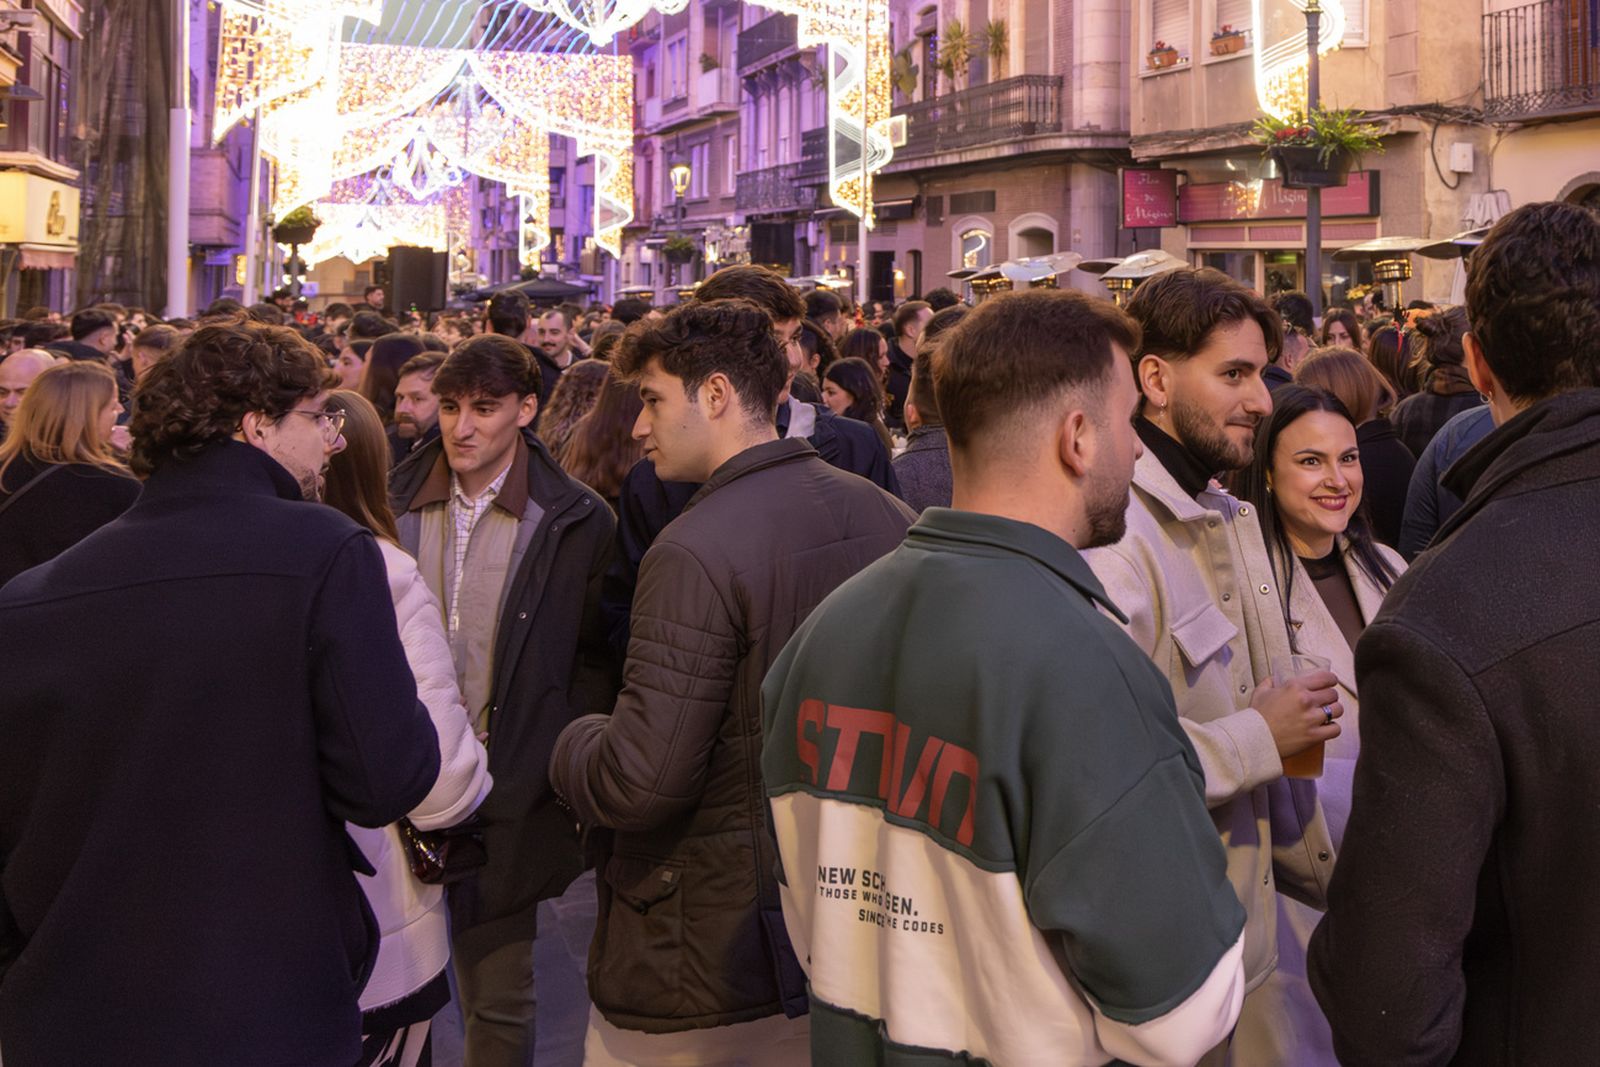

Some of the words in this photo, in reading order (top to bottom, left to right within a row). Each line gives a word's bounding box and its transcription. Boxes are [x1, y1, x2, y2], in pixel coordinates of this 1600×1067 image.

[818, 865, 857, 886] NEW
[820, 886, 857, 900] THOSE
[862, 891, 883, 907] WHO
[902, 919, 944, 934] CODES
